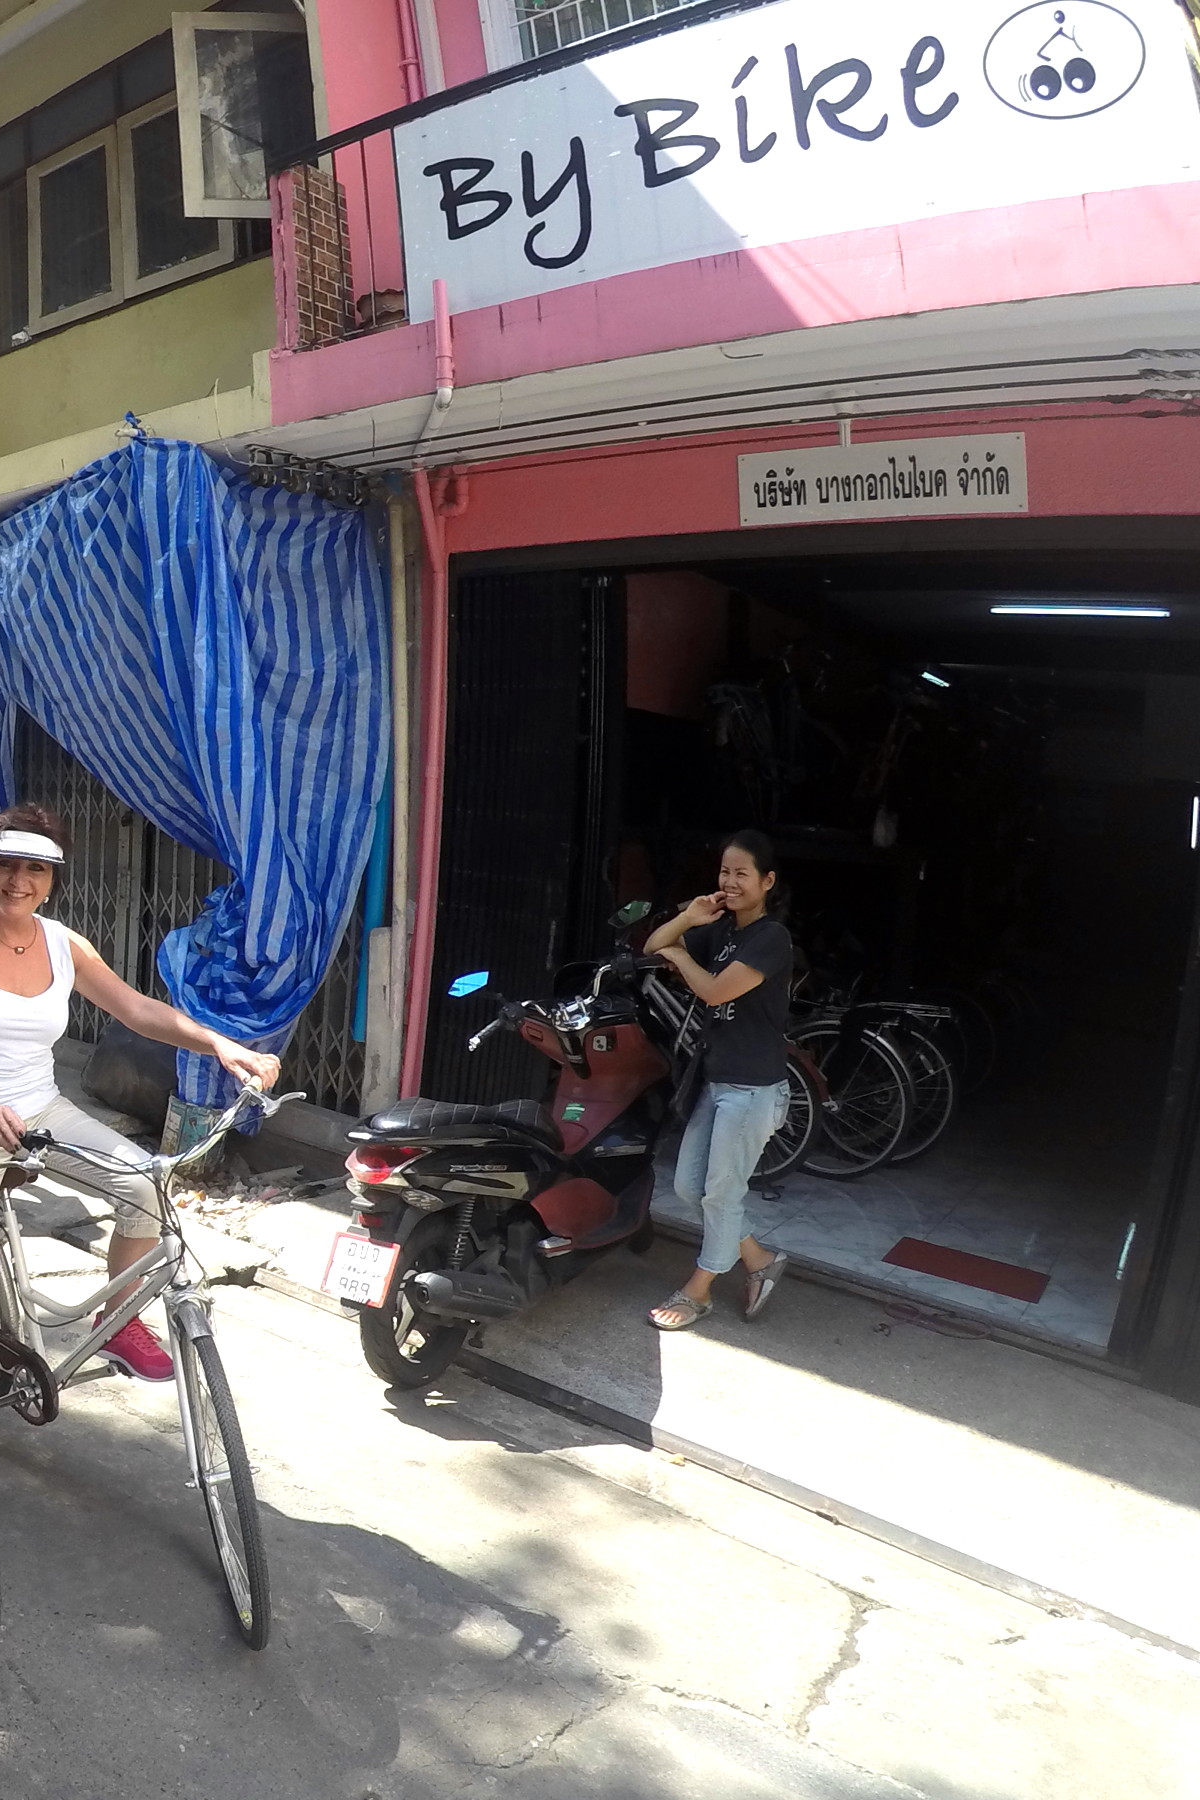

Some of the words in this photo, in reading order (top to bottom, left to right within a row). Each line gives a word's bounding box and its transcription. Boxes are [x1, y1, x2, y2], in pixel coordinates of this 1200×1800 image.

[615, 35, 960, 189] Bike
[753, 466, 807, 508] บริษัท
[815, 455, 948, 504] บางกอกไบไบค
[956, 451, 1010, 496] จำกัด
